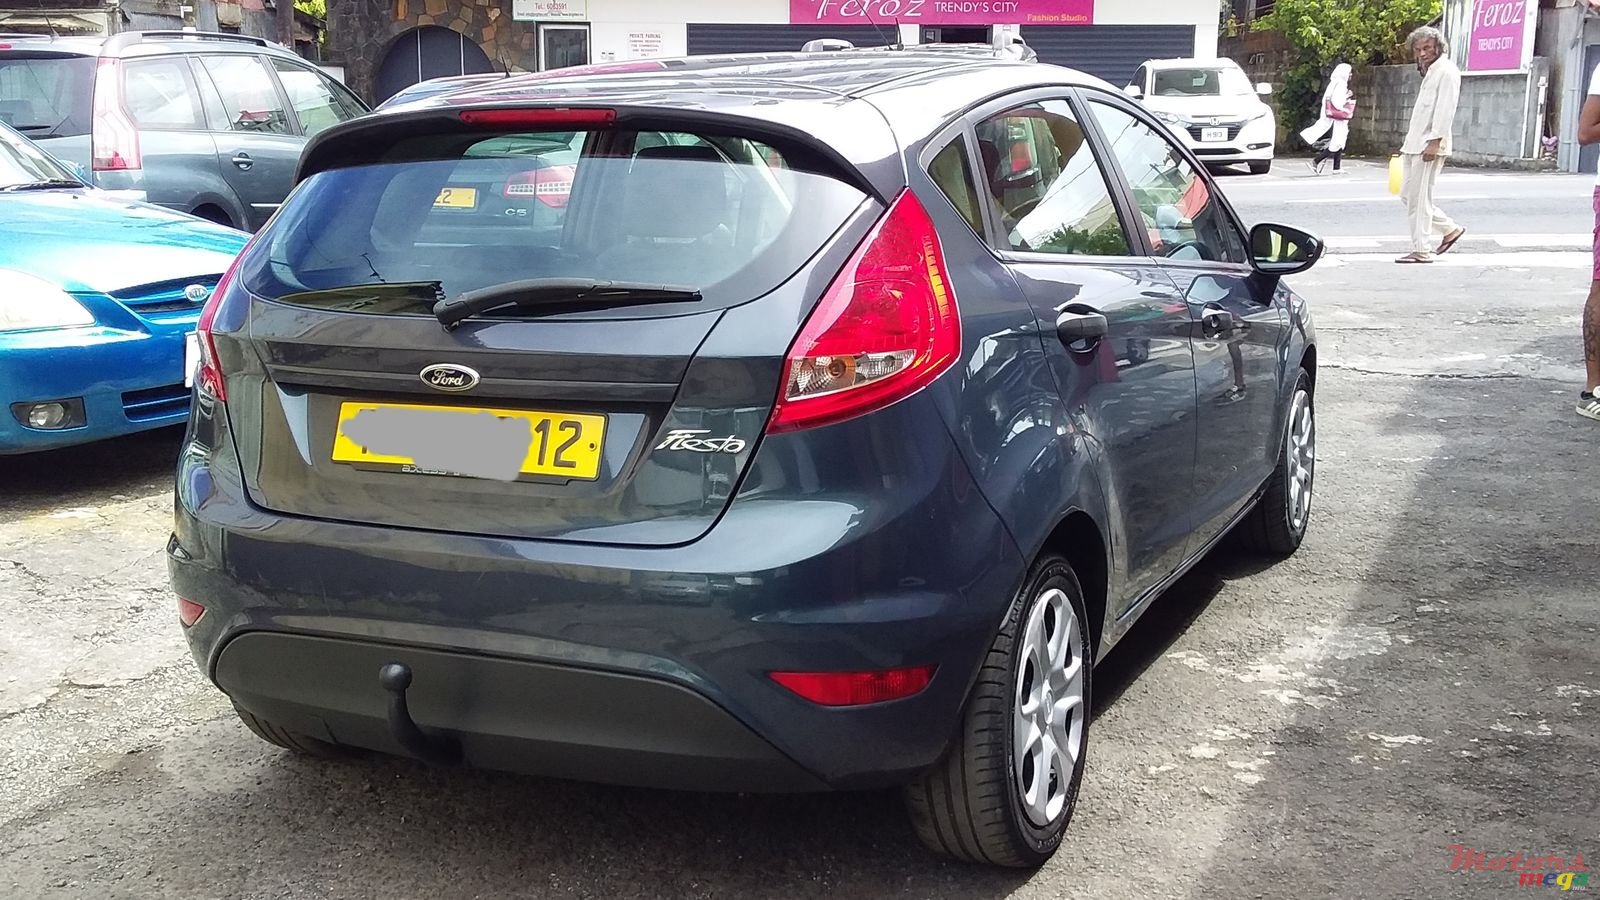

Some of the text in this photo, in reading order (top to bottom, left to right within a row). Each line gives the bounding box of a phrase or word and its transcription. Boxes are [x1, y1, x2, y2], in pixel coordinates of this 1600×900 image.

[811, 0, 925, 19] Feroz
[935, 2, 1018, 12] TRENDY'S CITY
[1027, 14, 1088, 22] Fashion Studio
[1473, 0, 1524, 32] Feroz
[1501, 36, 1514, 50] CITY
[505, 208, 527, 216] C5
[431, 369, 464, 386] Ford
[655, 429, 746, 454] Fiesta
